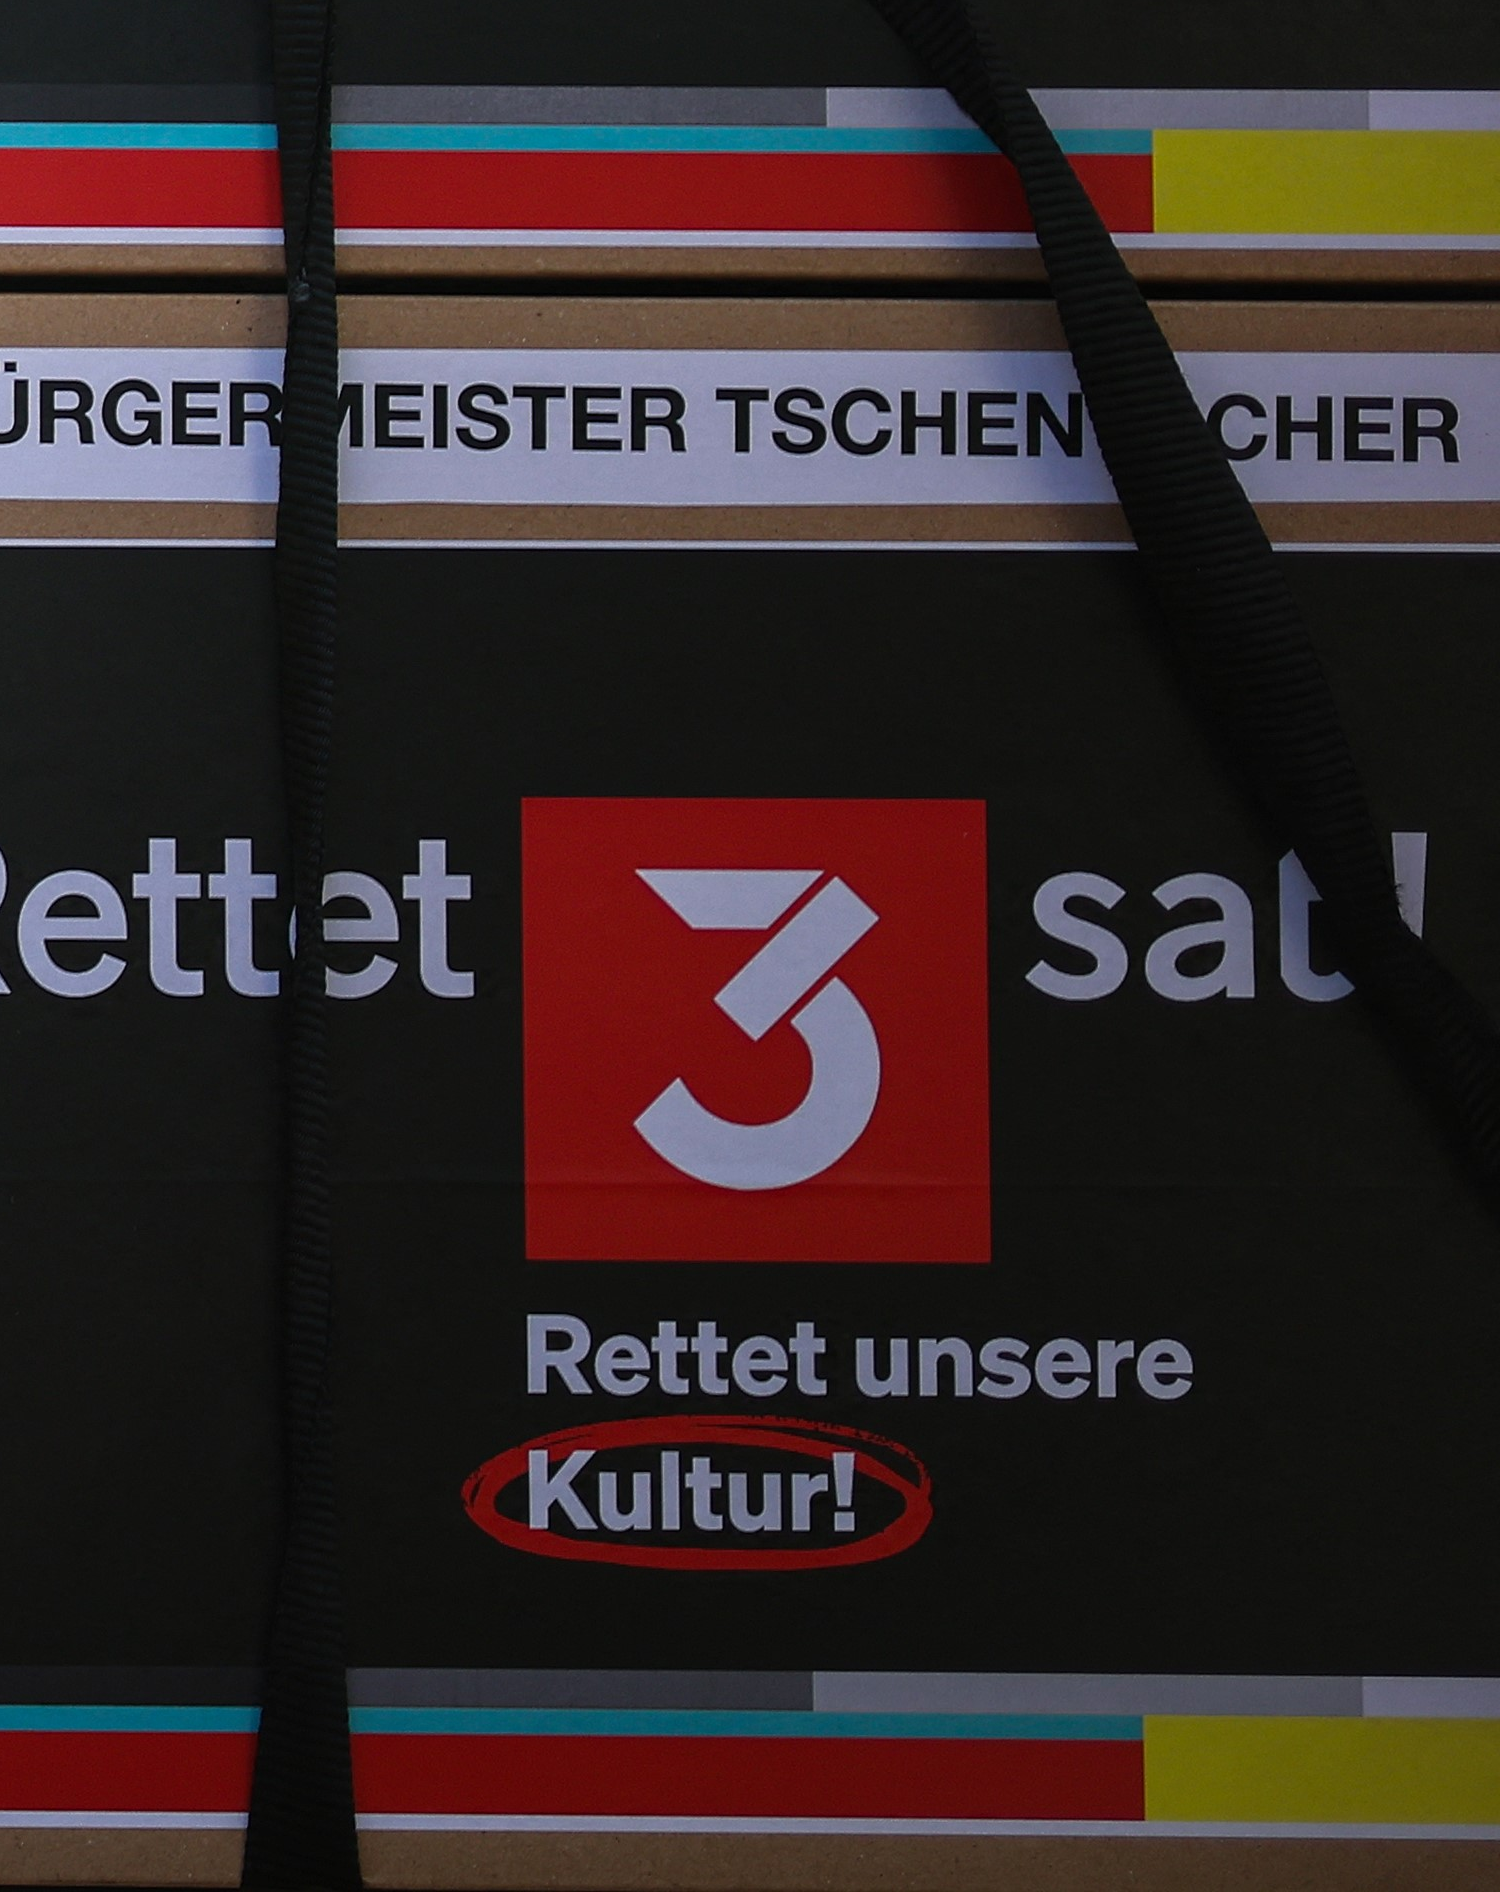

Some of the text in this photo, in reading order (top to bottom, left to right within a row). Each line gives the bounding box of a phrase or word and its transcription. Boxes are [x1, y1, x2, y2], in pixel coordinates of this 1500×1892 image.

[714, 386, 1461, 466] TSCHENCHER
[632, 867, 882, 1192] 3
[525, 1312, 1195, 1401] Rettet unsere
[527, 1448, 856, 1533] Kultur!
